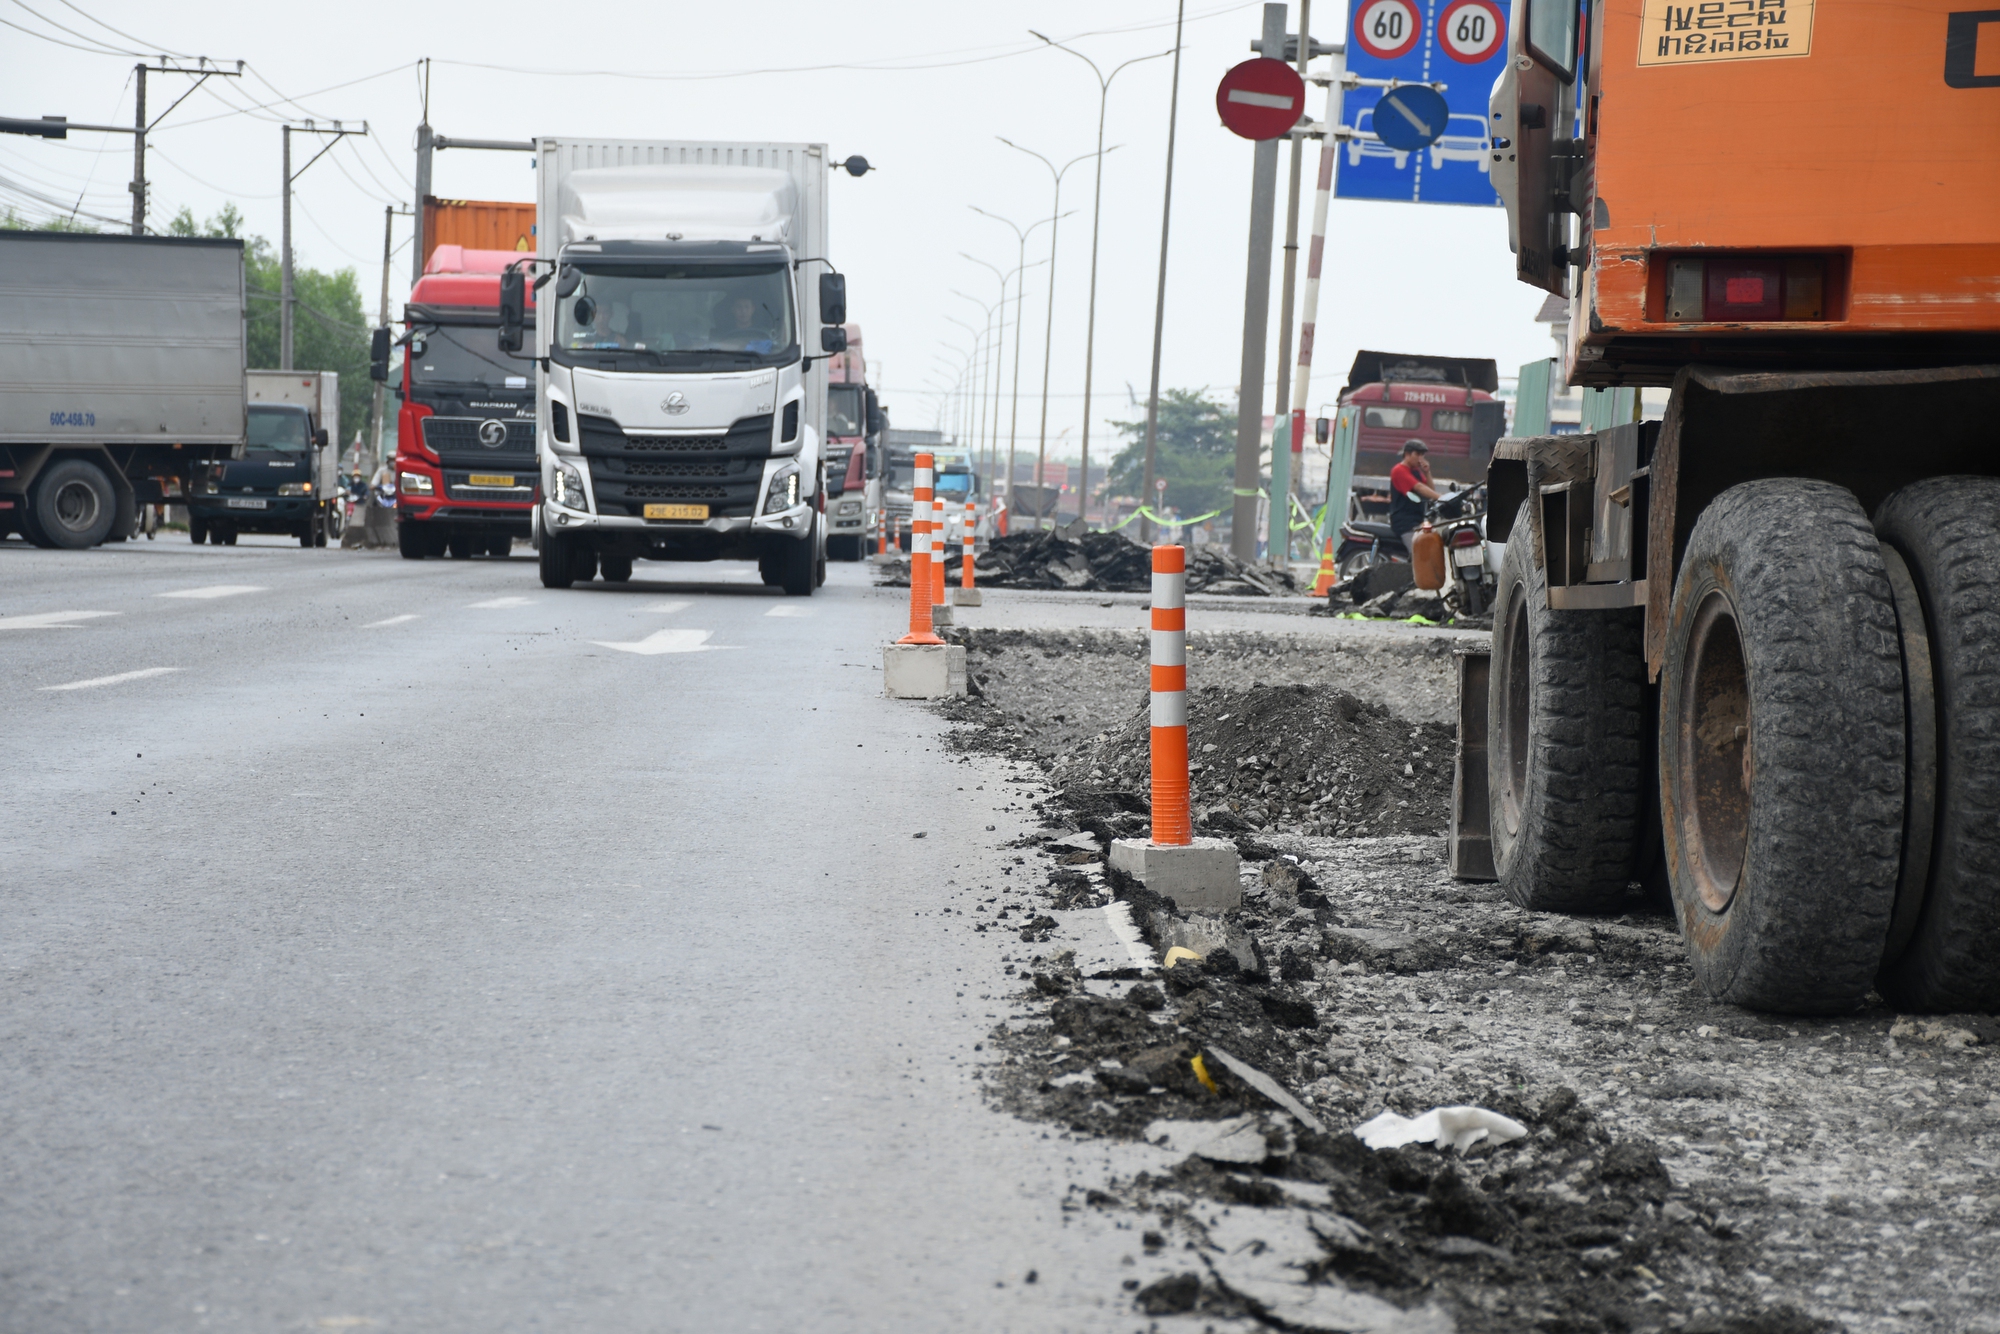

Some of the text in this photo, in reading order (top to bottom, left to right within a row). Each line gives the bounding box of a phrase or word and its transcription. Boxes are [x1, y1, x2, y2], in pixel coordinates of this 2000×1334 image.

[1374, 10, 1402, 39] 60
[1457, 14, 1485, 43] 60
[1665, 0, 1787, 31] 접근금지
[1657, 28, 1789, 56] 작업반경내
[50, 411, 96, 427] 60C-458.70
